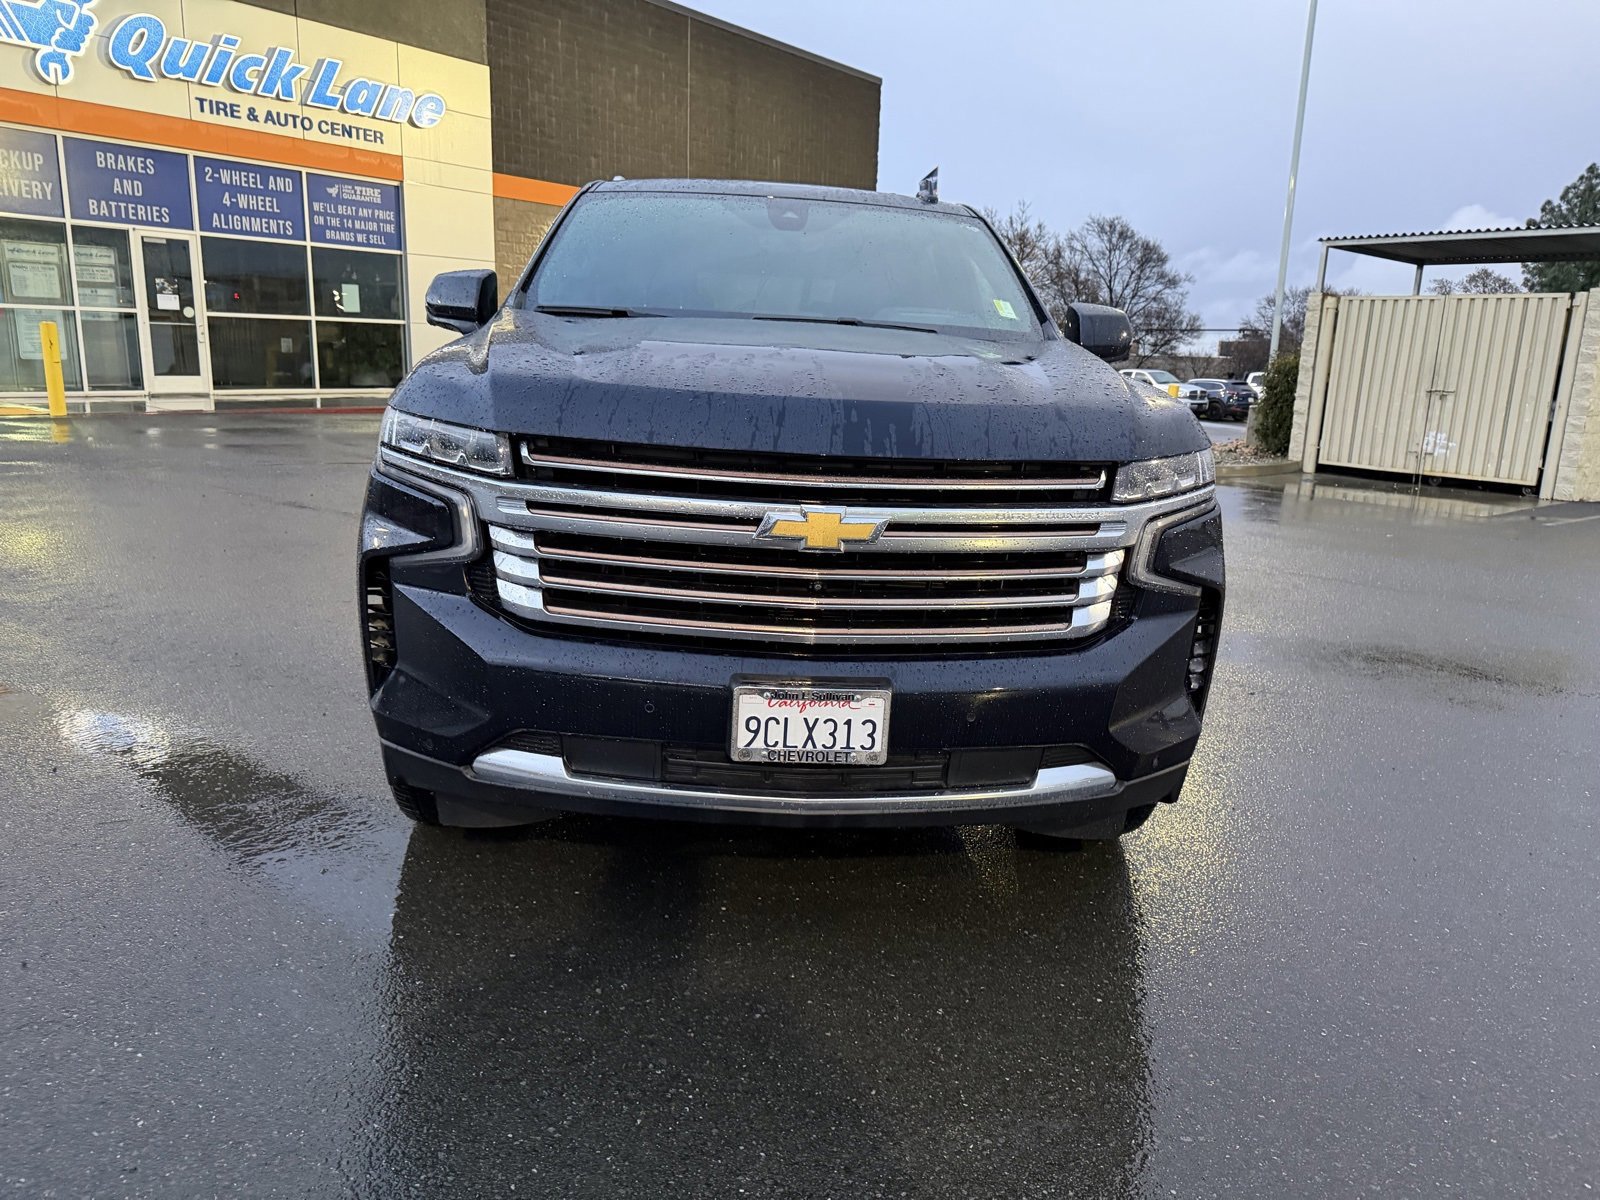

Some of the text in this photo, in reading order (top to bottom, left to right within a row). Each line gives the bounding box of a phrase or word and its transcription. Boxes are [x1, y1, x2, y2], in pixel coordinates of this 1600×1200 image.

[109, 13, 446, 128] Quick Lane
[195, 97, 385, 145] TIRE & AUTO CENTER
[96, 151, 156, 175] BRAKES
[0, 176, 53, 201] IVERY
[113, 177, 143, 197] AND
[204, 166, 293, 193] 2-WHEEL AND
[222, 191, 281, 213] 4-WHEEL
[342, 193, 382, 204] GUARANTEE
[354, 185, 382, 198] TIRE
[88, 199, 170, 224] BATTERIES
[312, 201, 395, 221] WE'LL BEAT ANY PRICE
[212, 213, 293, 236] ALIGNMENTS
[313, 215, 396, 234] ON THE 14 MAJOR TIRE
[325, 229, 386, 245] BRANDS WE SELL
[771, 691, 798, 701] John
[812, 691, 855, 702] Sullivan
[743, 715, 877, 751] 9CLX313
[767, 750, 851, 763] CHEVROLET
